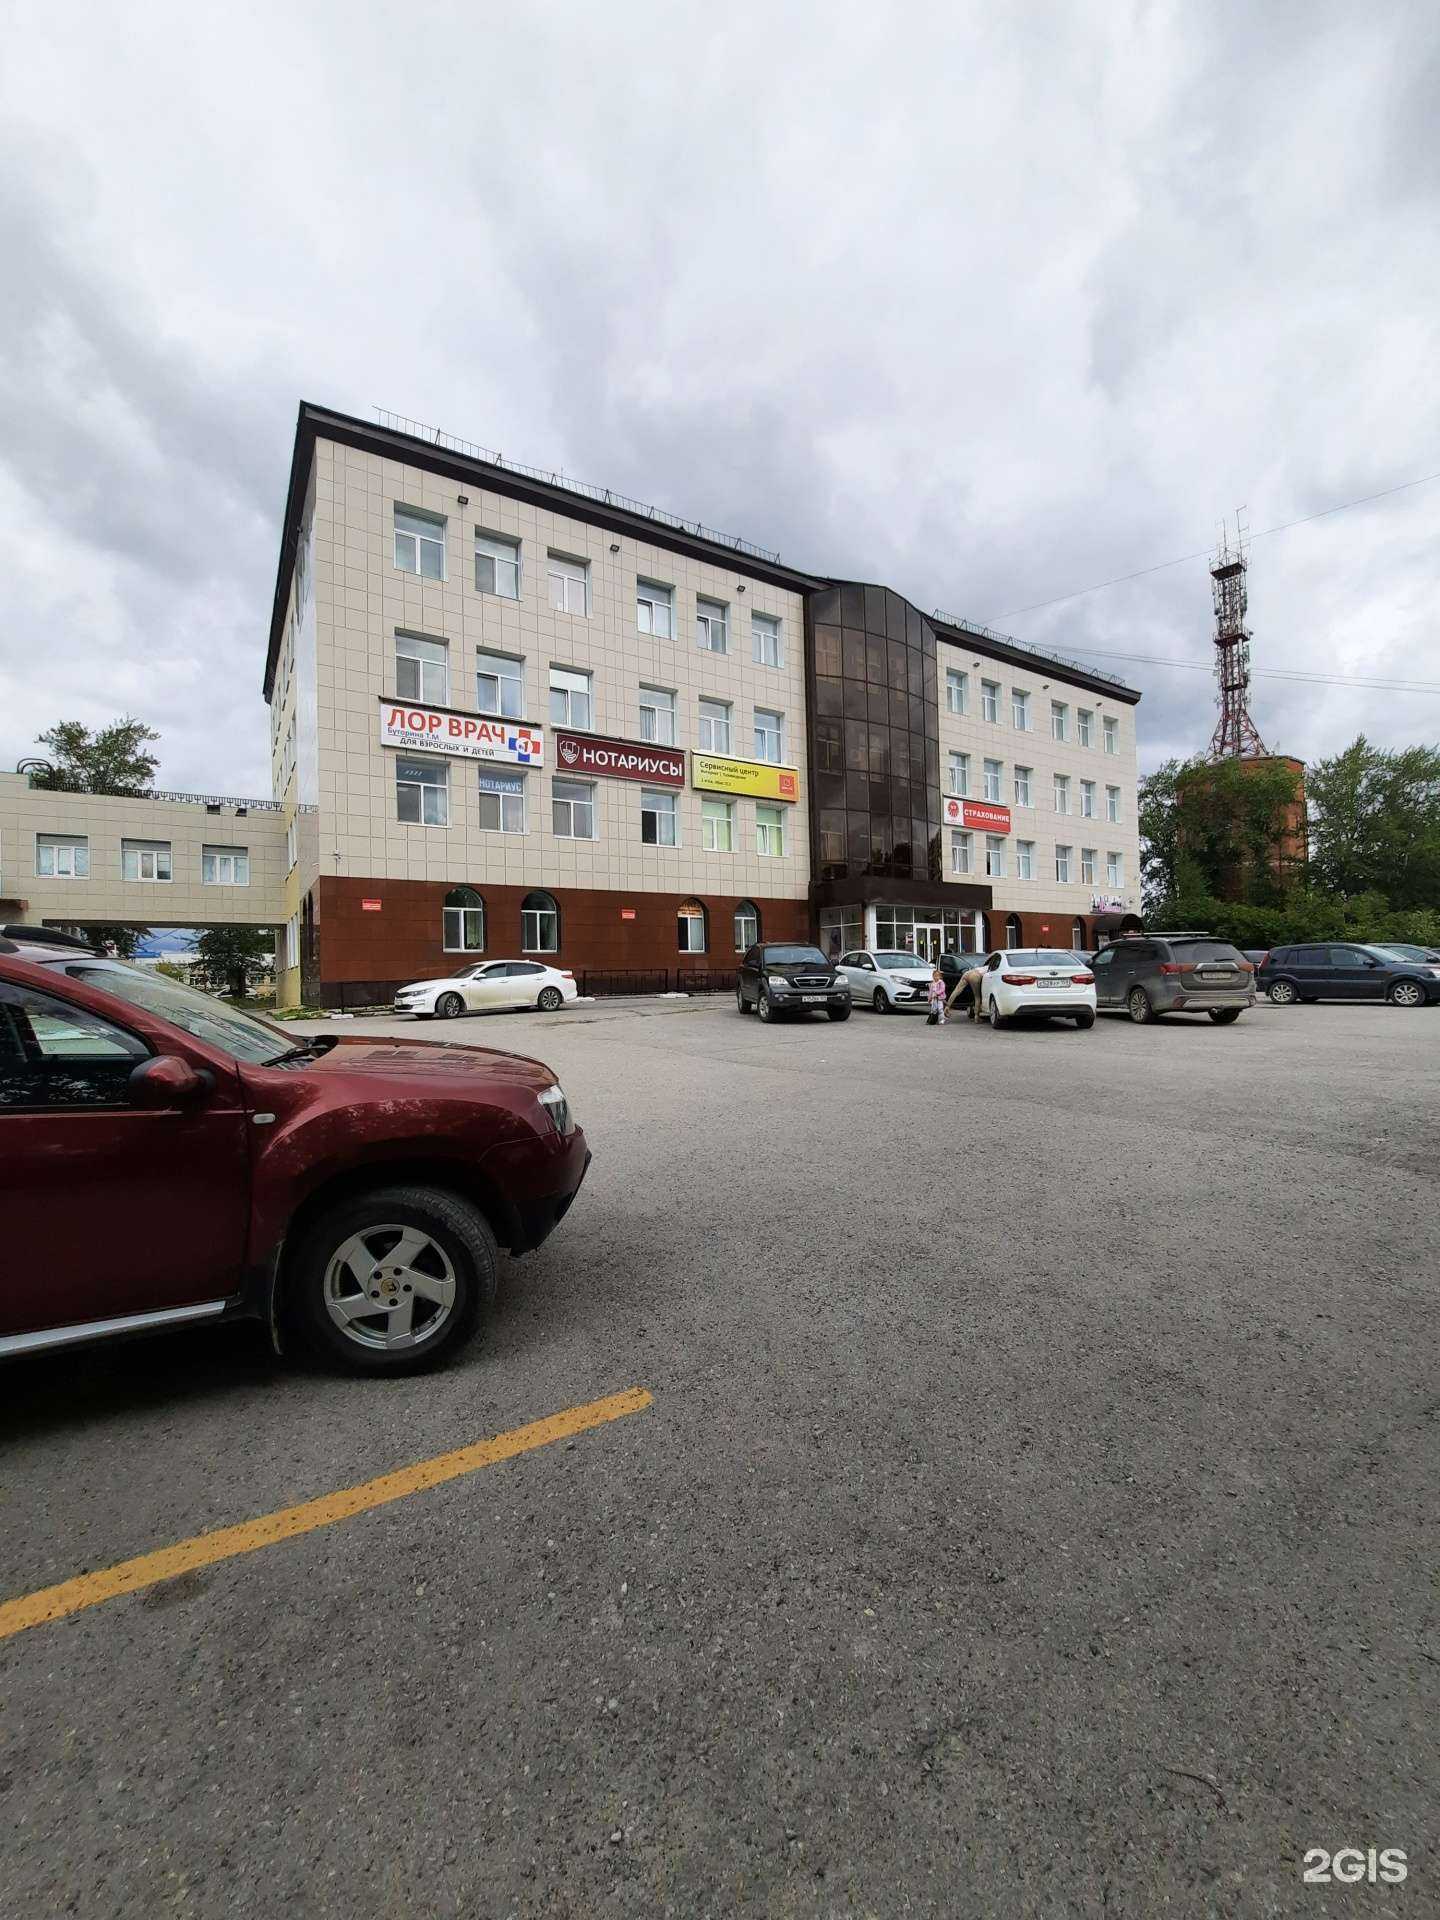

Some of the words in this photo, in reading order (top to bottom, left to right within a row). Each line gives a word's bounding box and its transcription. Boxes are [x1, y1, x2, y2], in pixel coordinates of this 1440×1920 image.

[387, 708, 443, 733] ЛОР
[448, 718, 506, 744] ВРАЧ
[400, 737, 417, 746] ДЛЯ
[419, 740, 460, 752] ВЗРОСЛЫХ
[463, 745, 469, 753] И
[472, 748, 495, 757] ДЕТЕЙ
[582, 748, 683, 777] НОТАРИУСЫ
[699, 761, 739, 774] Сервисный
[740, 768, 759, 777] центр
[480, 777, 522, 792] НОТАРИУС
[964, 808, 1010, 823] СТРАХОВАНИЕ
